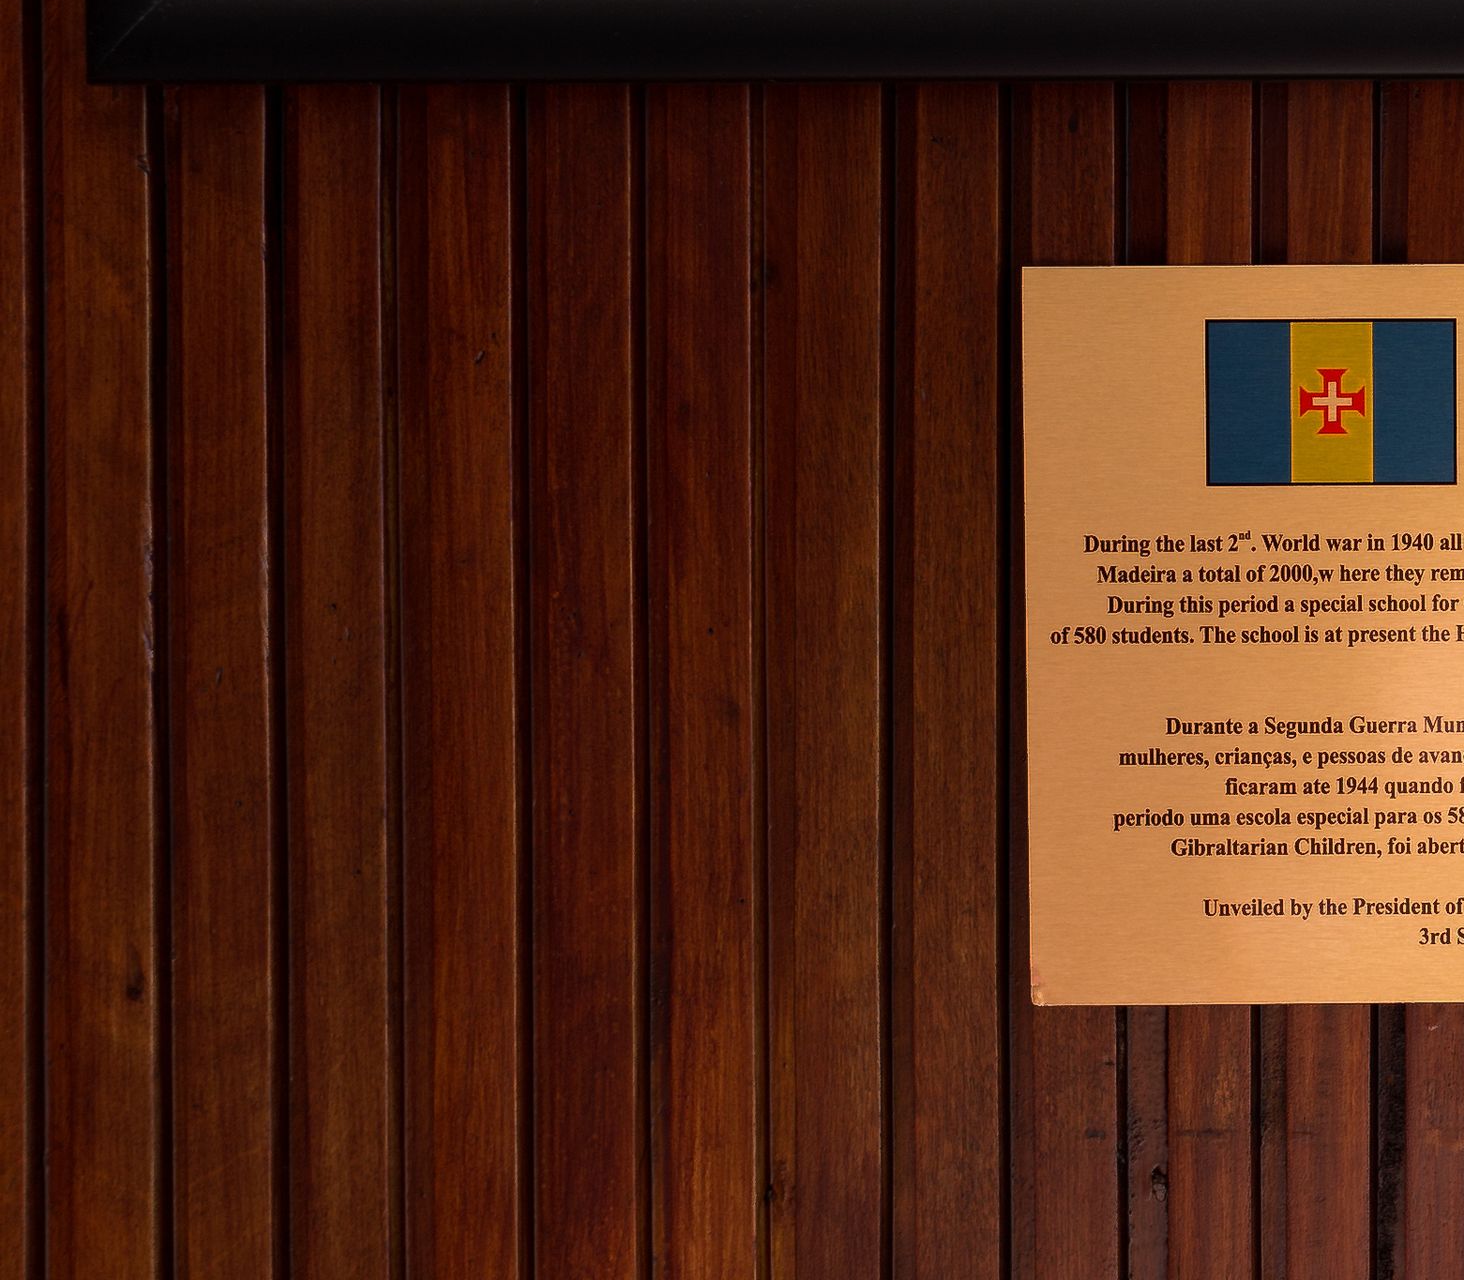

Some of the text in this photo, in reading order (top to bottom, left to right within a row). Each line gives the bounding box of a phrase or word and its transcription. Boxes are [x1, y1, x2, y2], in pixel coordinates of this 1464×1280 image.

[1082, 534, 1151, 558] During
[1155, 534, 1186, 553] the
[1189, 534, 1224, 553] last
[1260, 533, 1321, 553] World
[1325, 538, 1363, 552] war
[1366, 533, 1386, 552] in
[1391, 532, 1434, 552] 1940
[1439, 532, 1463, 551] all
[1096, 564, 1177, 584] Madeira
[1182, 569, 1194, 583] a
[1198, 564, 1242, 583] total
[1245, 564, 1267, 583] of
[1339, 564, 1381, 582] here
[1384, 563, 1426, 587] they
[1107, 595, 1175, 619] During
[1178, 594, 1214, 614] this
[1218, 594, 1279, 619] period
[1284, 599, 1295, 613] a
[1300, 594, 1364, 618] special
[1368, 594, 1427, 613] school
[1431, 593, 1460, 612] for
[1049, 626, 1071, 645] of
[1073, 625, 1107, 645] 580
[1111, 625, 1195, 645] students.
[1199, 625, 1237, 644] The
[1241, 625, 1300, 644] school
[1303, 624, 1319, 644] is
[1324, 626, 1344, 643] at
[1347, 626, 1417, 648] present
[1421, 624, 1451, 643] the
[1165, 717, 1244, 736] Durante
[1247, 721, 1259, 735] a
[1264, 716, 1345, 740] Segunda
[1349, 715, 1418, 734] Guerra
[1118, 747, 1210, 770] mulheres,
[1214, 746, 1297, 770] crianças,
[1302, 751, 1313, 765] e
[1317, 750, 1386, 770] pessoas
[1391, 746, 1414, 764] de
[1224, 777, 1298, 796] ficaram
[1302, 778, 1331, 795] ate
[1336, 776, 1379, 795] 1944
[1384, 776, 1454, 800] quando
[1112, 808, 1185, 832] periodo
[1189, 812, 1231, 827] uma
[1235, 807, 1292, 826] escola
[1296, 806, 1370, 831] especial
[1373, 811, 1418, 830] para
[1423, 811, 1443, 825] os
[1170, 837, 1289, 857] Gibraltarian
[1294, 836, 1383, 859] Children,
[1386, 836, 1412, 855] foi
[1201, 898, 1285, 917] Unveiled
[1289, 898, 1314, 921] by
[1318, 897, 1348, 916] the
[1352, 897, 1441, 916] President
[1418, 927, 1452, 946] 3rd
